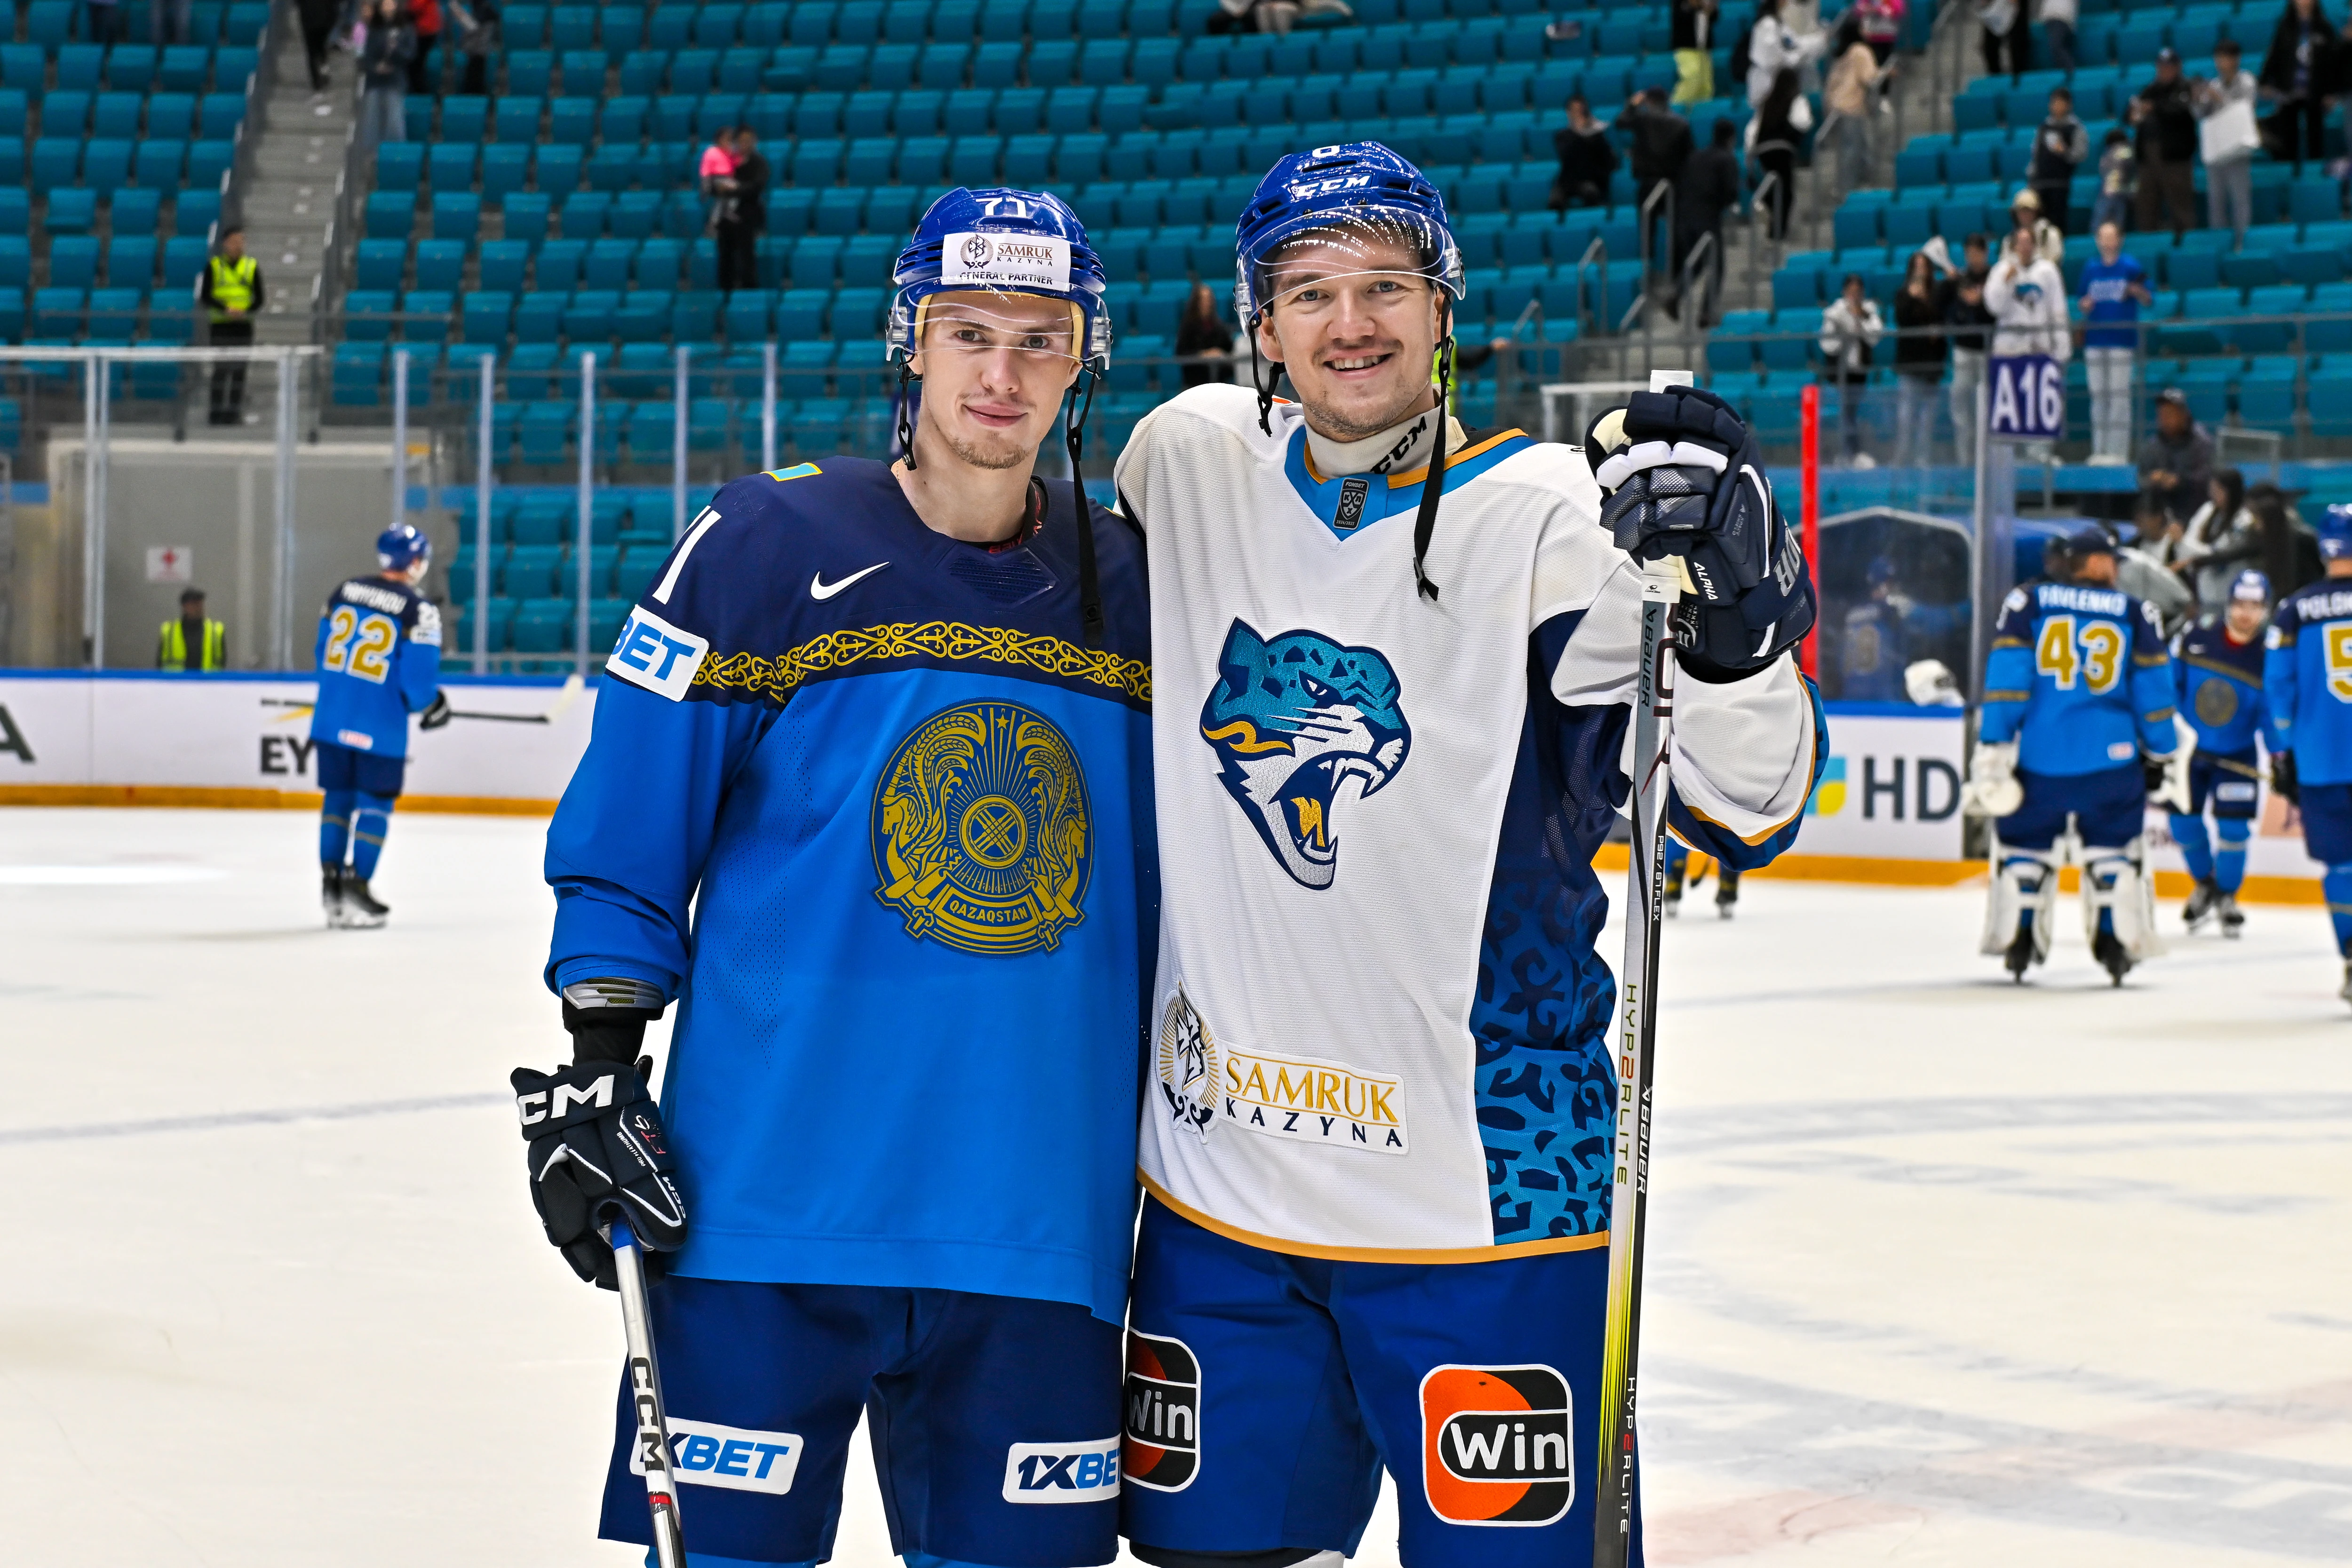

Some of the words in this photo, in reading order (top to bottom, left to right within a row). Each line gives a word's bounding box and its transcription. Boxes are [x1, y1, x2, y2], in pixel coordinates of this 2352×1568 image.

[976, 197, 1026, 217] 71
[1295, 175, 1371, 197] CCM
[997, 256, 1053, 267] KAZYNA
[998, 244, 1053, 259] SAMRUK
[1008, 273, 1053, 285] PARTNER
[1991, 363, 2062, 432] A16
[1369, 415, 1427, 474] CCM
[1693, 562, 1718, 601] ALPHA
[322, 605, 397, 684] 22
[2035, 614, 2126, 696] 43
[261, 734, 314, 775] EY
[949, 899, 1028, 923] QAZAQSTAN
[1225, 1056, 1398, 1123] SAMRUK
[1225, 1097, 1403, 1147] KAZYNA
[662, 1176, 687, 1219] CCM
[630, 1357, 665, 1472] CCM
[1129, 1389, 1193, 1441] Win
[1450, 1423, 1566, 1471] Win
